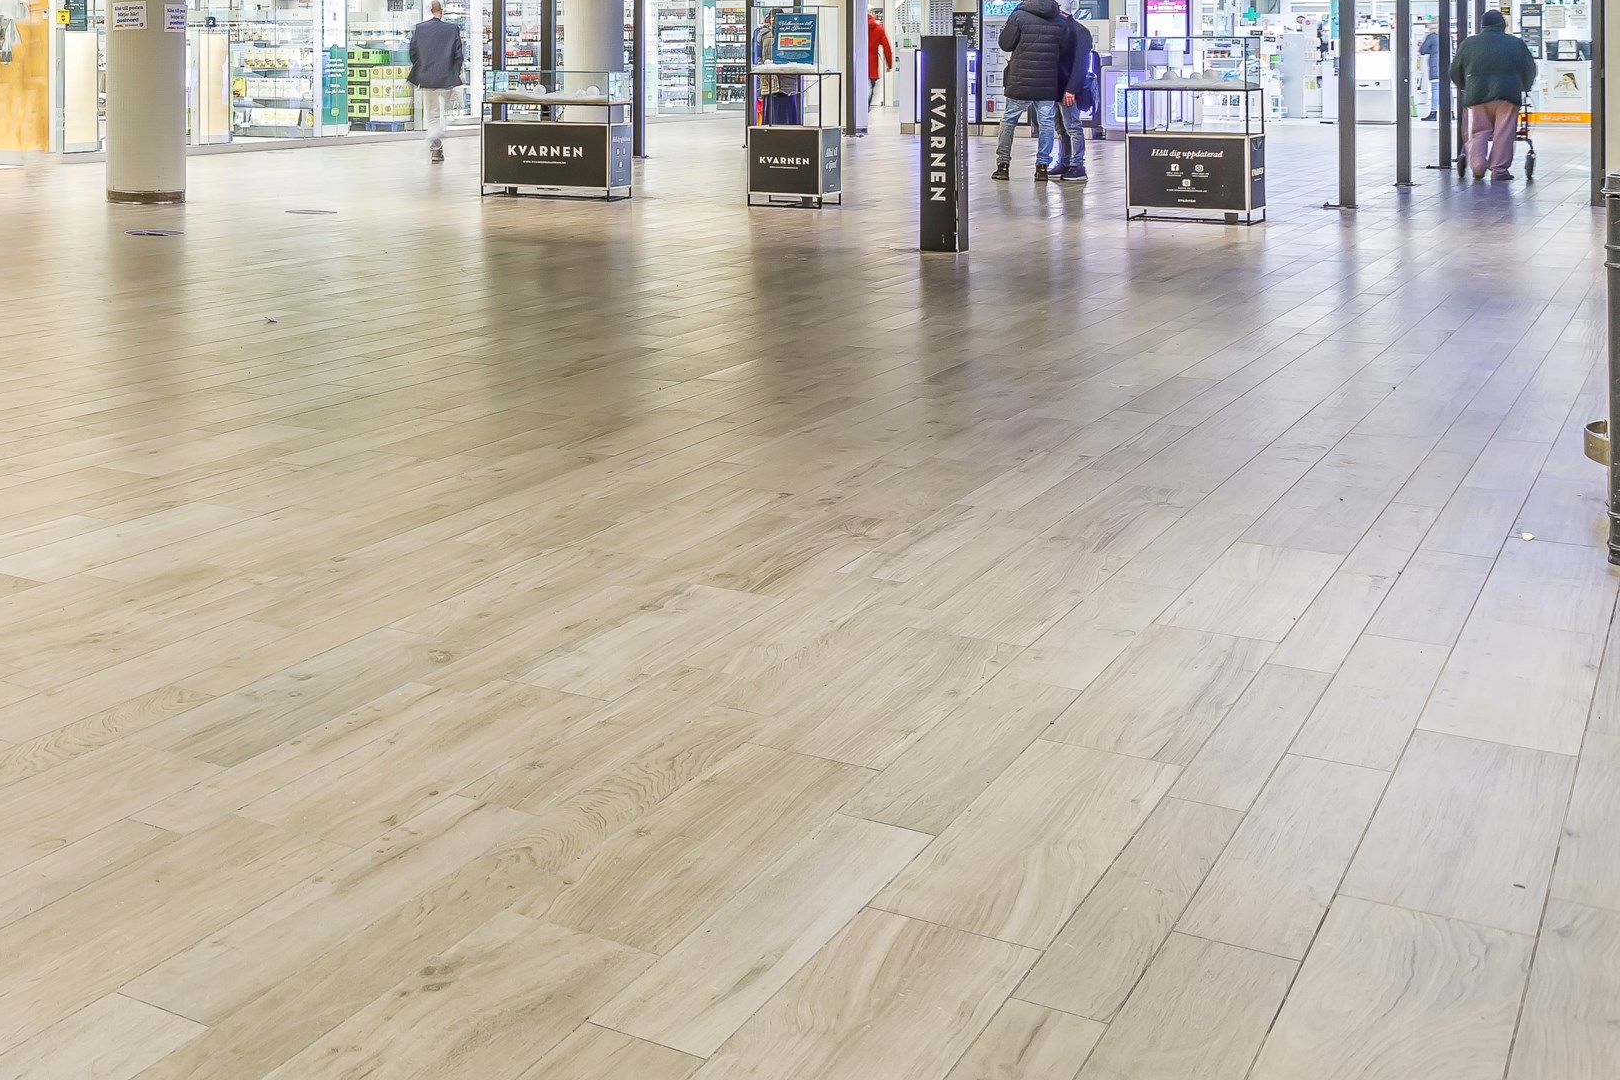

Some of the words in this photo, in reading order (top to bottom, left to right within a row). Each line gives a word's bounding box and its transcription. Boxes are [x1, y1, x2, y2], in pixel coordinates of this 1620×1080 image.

[930, 88, 946, 201] KVARNEN
[507, 144, 583, 158] KVARNEN
[1151, 148, 1169, 158] Håll
[1169, 149, 1181, 159] dig
[1182, 150, 1224, 159] uppdaterad
[759, 156, 810, 165] KVARNEN
